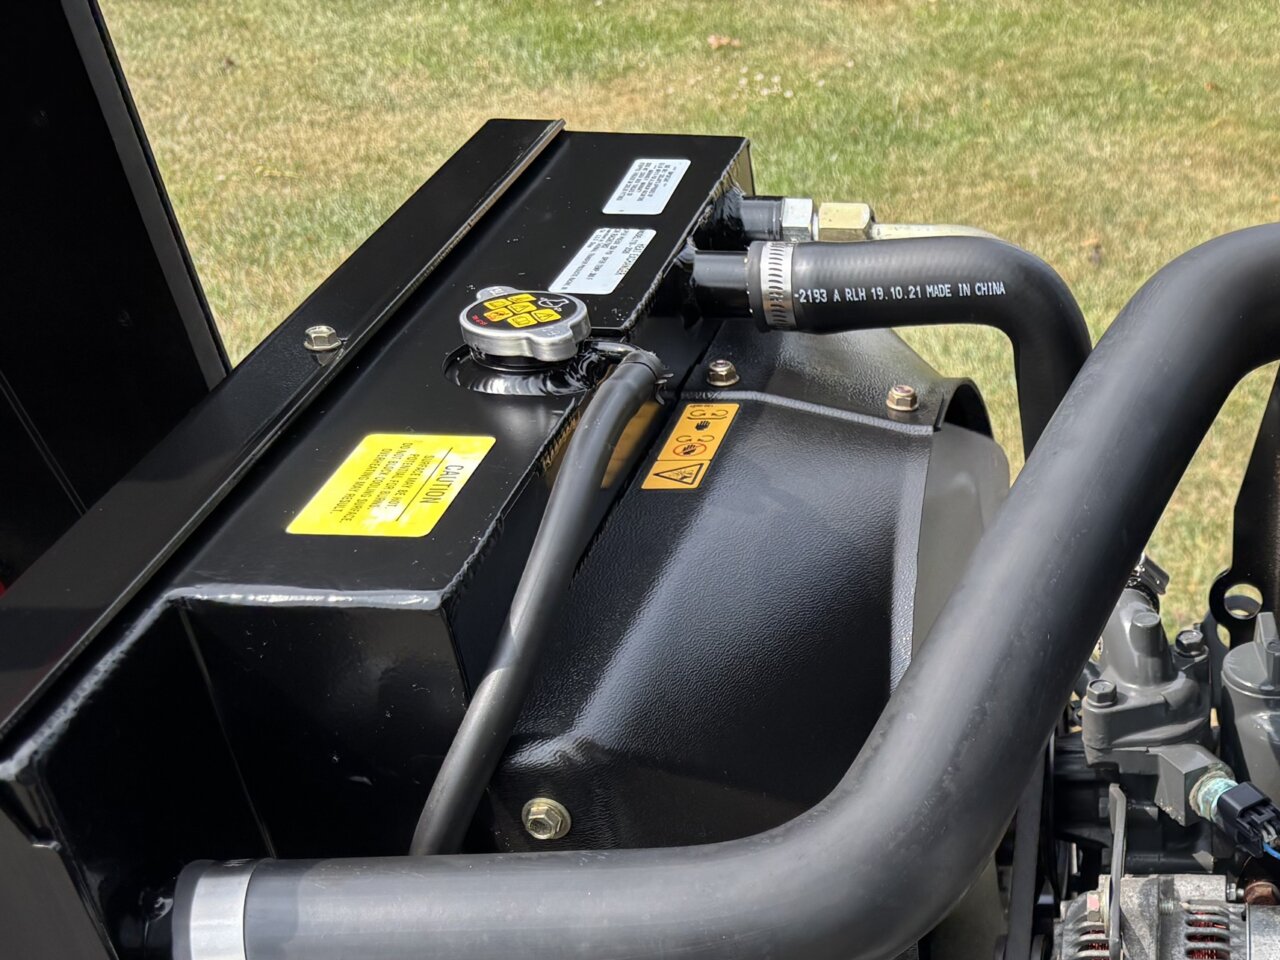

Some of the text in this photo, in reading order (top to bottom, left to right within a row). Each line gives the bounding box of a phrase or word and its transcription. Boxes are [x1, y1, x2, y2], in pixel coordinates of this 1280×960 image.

[833, 291, 841, 302] A
[846, 287, 866, 301] RLH
[871, 285, 922, 300] 19.10.21
[926, 283, 951, 298] MADE
[959, 282, 971, 296] IN
[975, 281, 1005, 296] CHINA
[357, 448, 393, 480] OVERHEATING
[390, 450, 406, 459] NOT
[377, 461, 398, 475] BLOCK
[391, 453, 420, 478] POTENTIAL
[409, 455, 435, 475] SURFACE
[347, 481, 365, 491] MAY
[359, 476, 385, 497] COOLING
[382, 479, 400, 489] FOR
[400, 477, 418, 487] MAY
[418, 464, 465, 503] CAUTION
